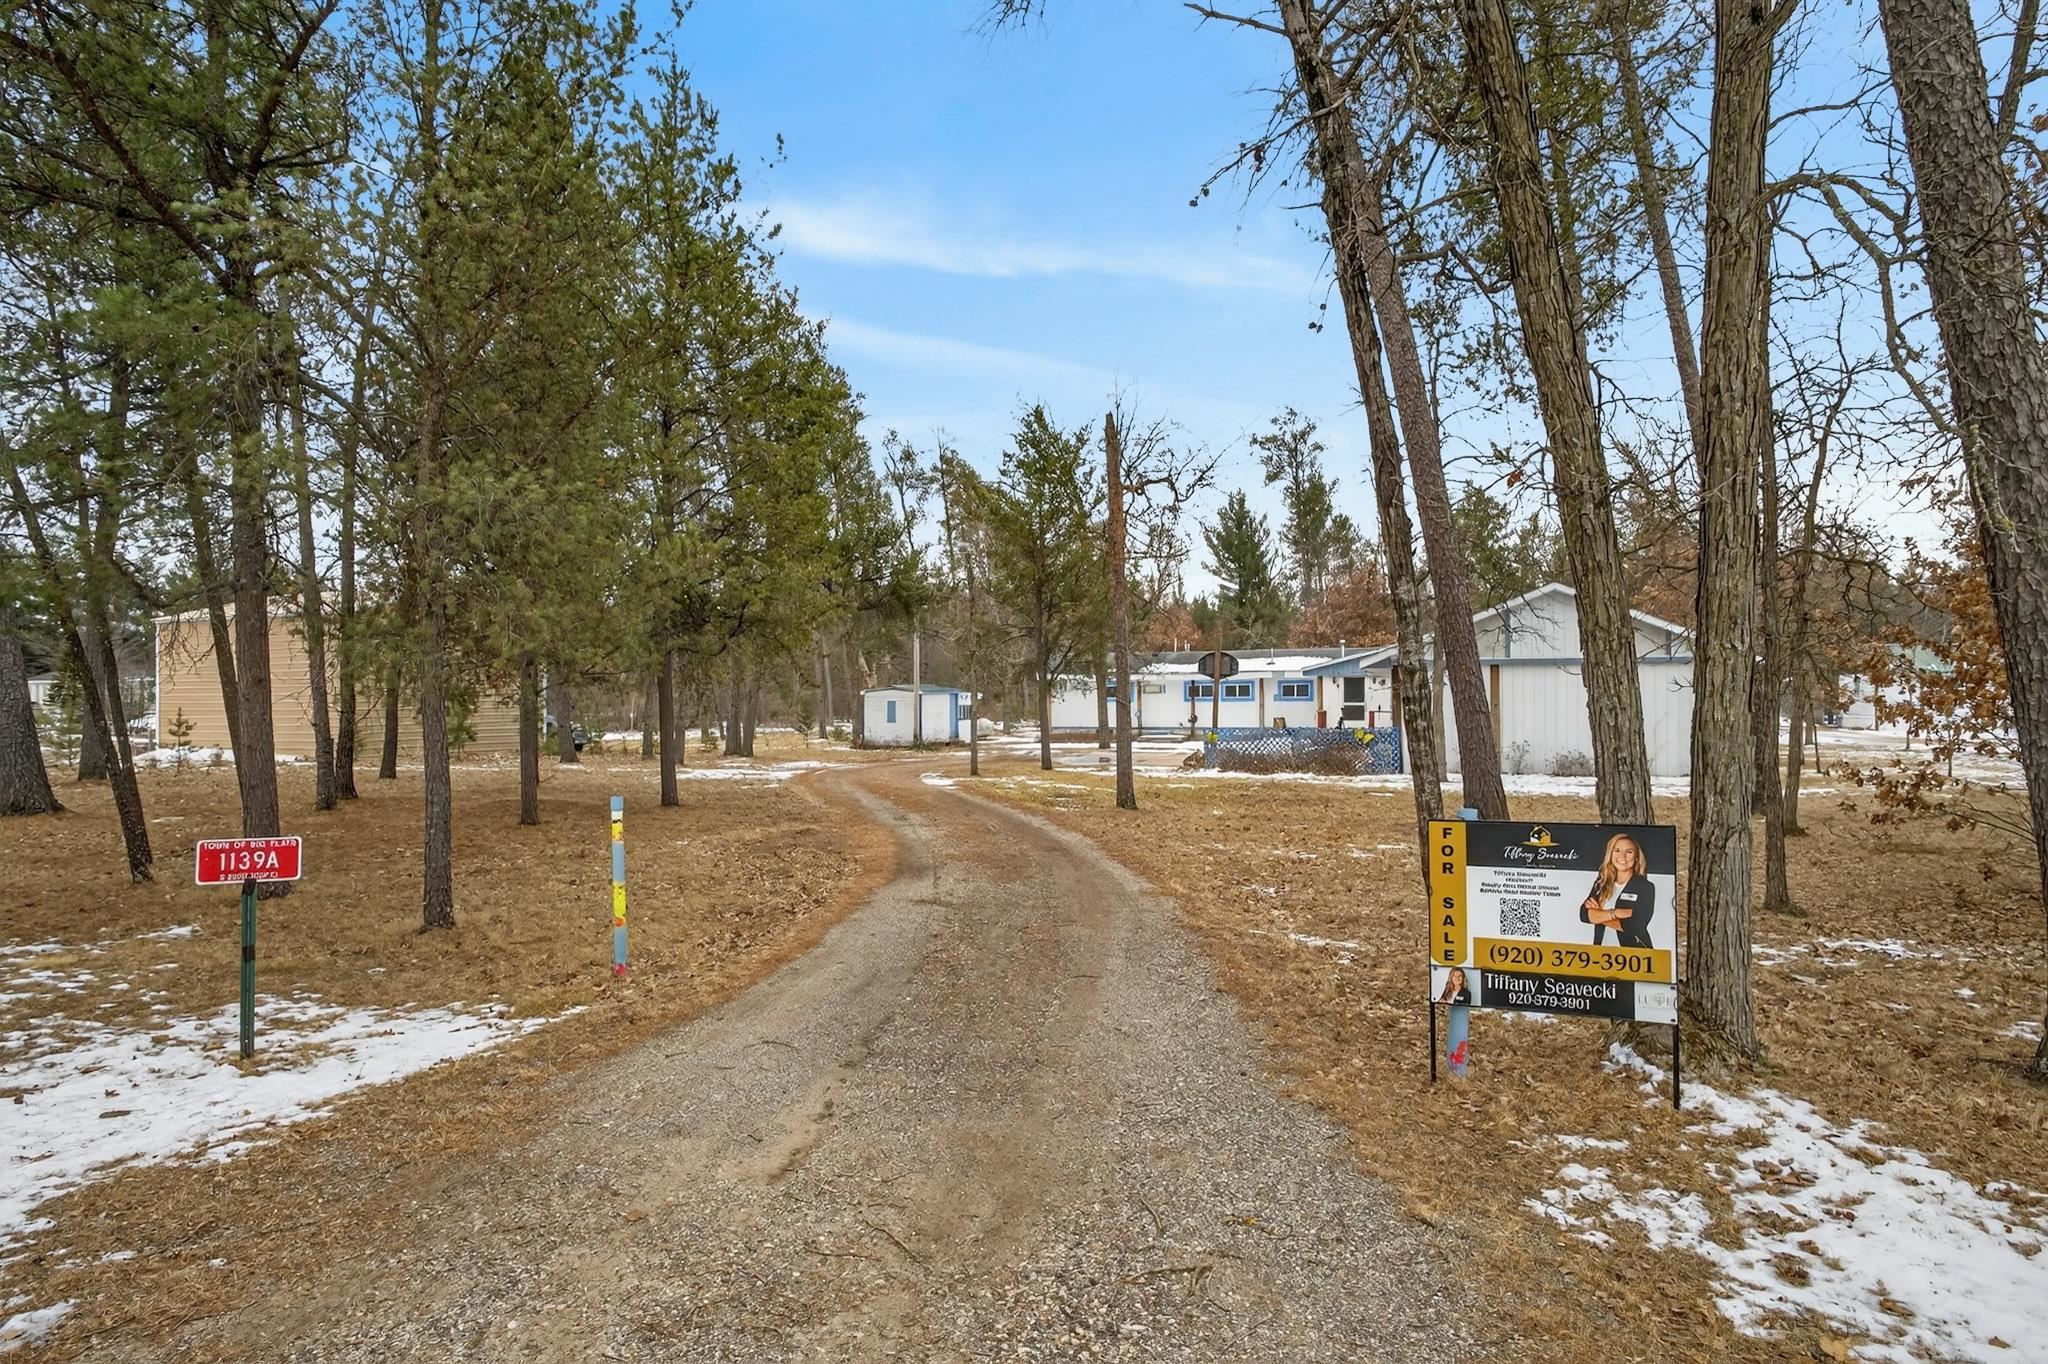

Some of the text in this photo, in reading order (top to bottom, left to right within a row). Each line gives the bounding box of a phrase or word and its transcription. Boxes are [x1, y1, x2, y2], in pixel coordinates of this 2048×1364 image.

[234, 841, 246, 849] OF
[219, 850, 280, 871] 1139A
[1441, 827, 1455, 961] FOR SALE
[1489, 943, 1655, 974] (920) 379-3901
[1484, 972, 1539, 995] Tiffany
[1544, 978, 1617, 1000] Seavecki
[1508, 991, 1591, 1011] 920-379-3901
